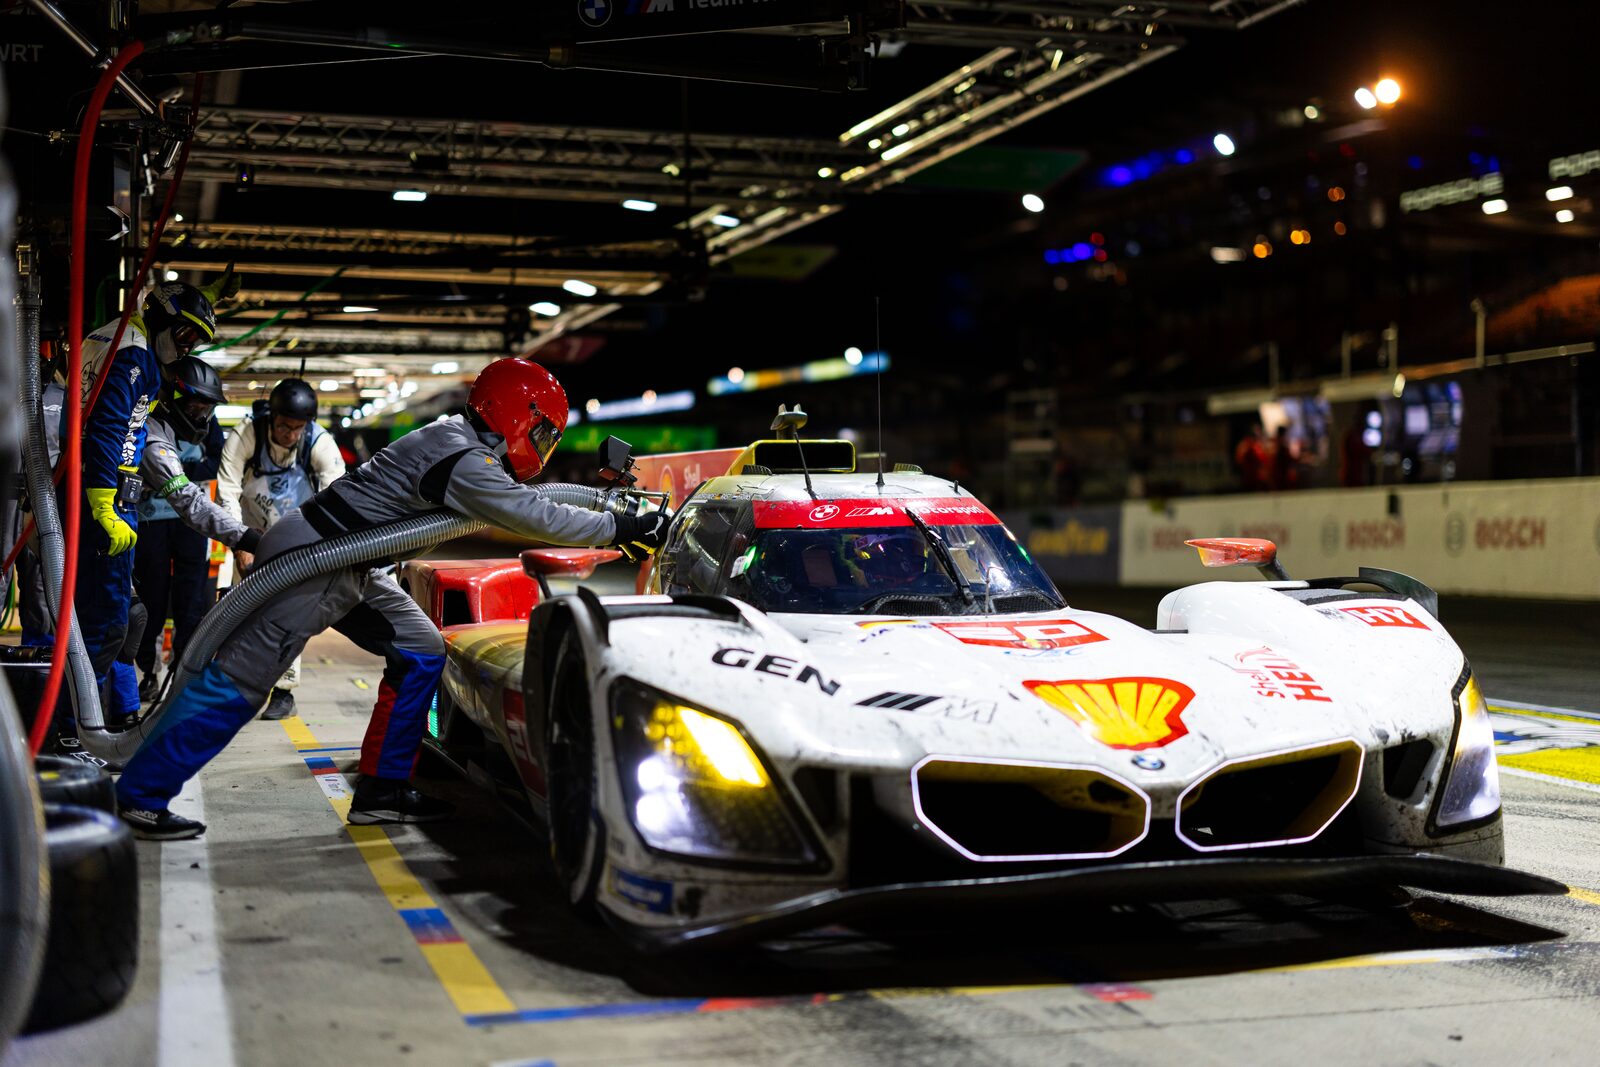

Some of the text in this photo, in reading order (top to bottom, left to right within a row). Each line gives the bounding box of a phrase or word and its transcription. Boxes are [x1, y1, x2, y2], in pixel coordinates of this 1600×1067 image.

[1475, 518, 1547, 549] BOSCH
[1346, 607, 1415, 625] HY
[712, 648, 841, 696] GEN
